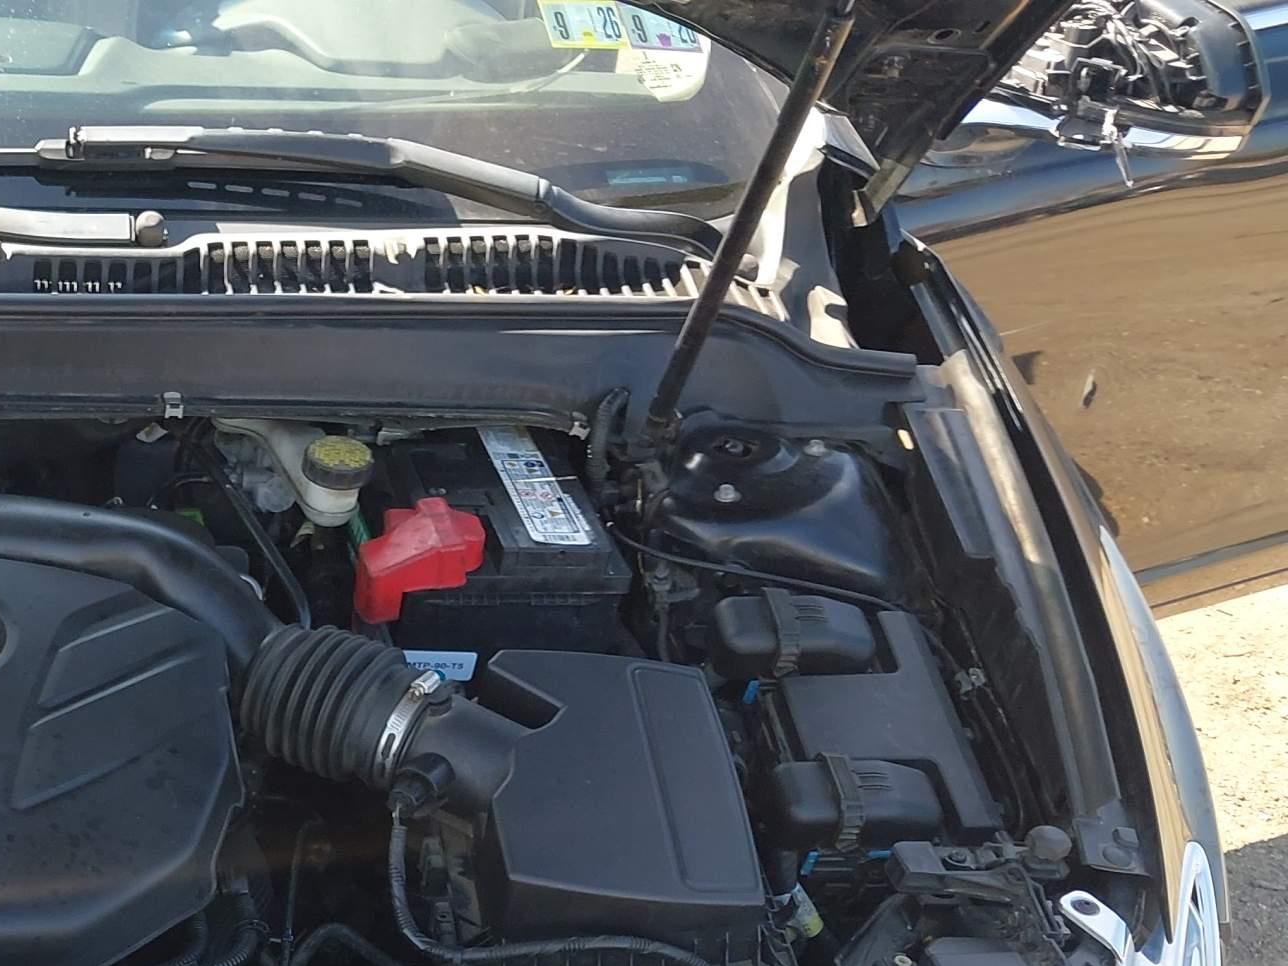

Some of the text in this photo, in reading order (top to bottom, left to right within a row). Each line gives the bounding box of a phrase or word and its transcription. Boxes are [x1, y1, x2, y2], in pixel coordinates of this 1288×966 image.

[553, 6, 622, 40] 9 26
[631, 14, 648, 43] 9
